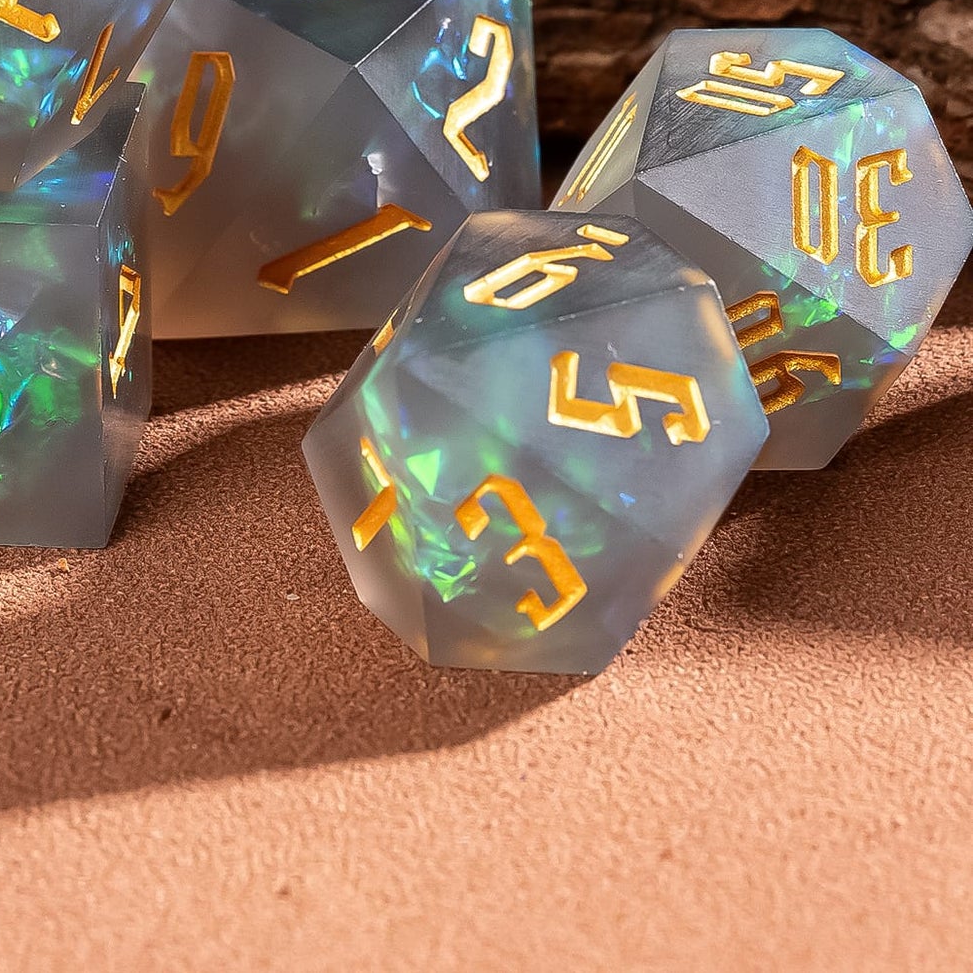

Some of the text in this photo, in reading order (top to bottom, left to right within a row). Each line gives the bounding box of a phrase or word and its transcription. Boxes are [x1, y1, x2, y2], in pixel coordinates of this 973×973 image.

[443, 14, 515, 182] 2
[257, 203, 433, 295] 1
[454, 474, 588, 631] 3
